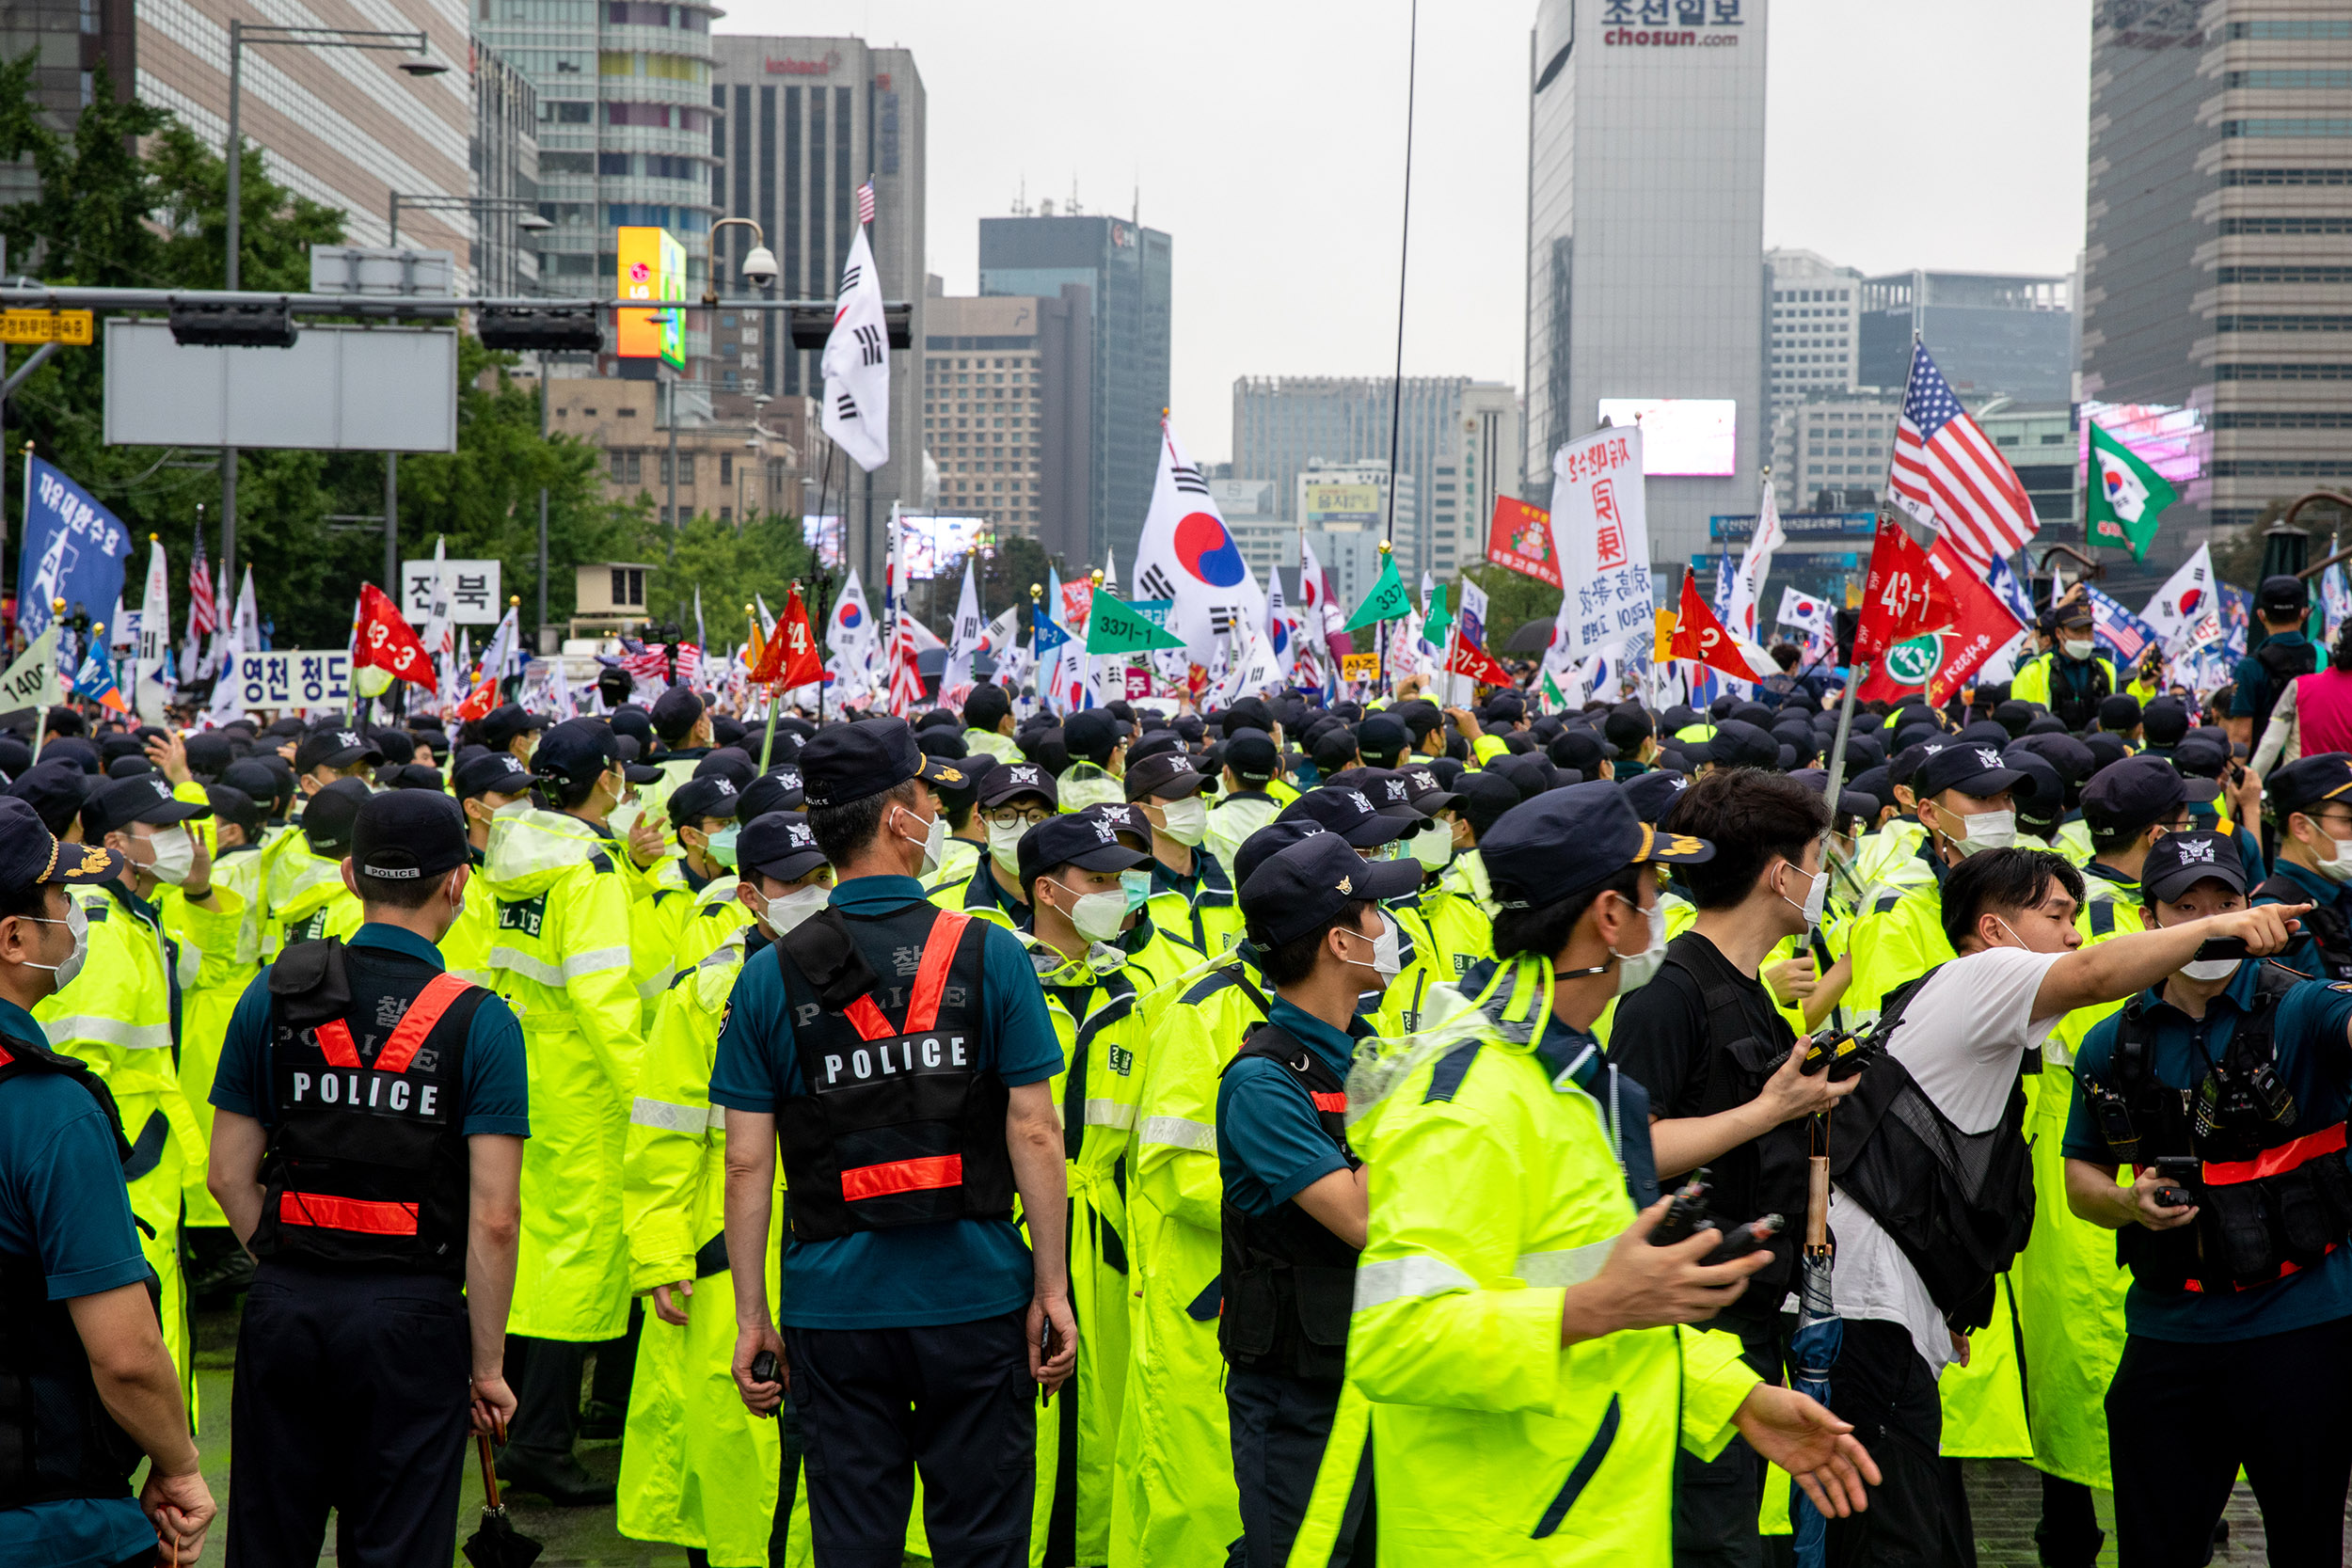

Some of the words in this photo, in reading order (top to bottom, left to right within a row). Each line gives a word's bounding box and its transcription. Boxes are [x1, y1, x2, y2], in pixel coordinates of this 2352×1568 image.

[1601, 0, 1744, 25] 조선일보
[1604, 26, 1739, 47] chosun.com
[629, 285, 650, 299] LG
[242, 657, 289, 703] 영천
[301, 657, 349, 703] 청도
[368, 867, 418, 879] POLICE
[824, 1037, 968, 1084] POLICE
[294, 1072, 438, 1116] POLICE
